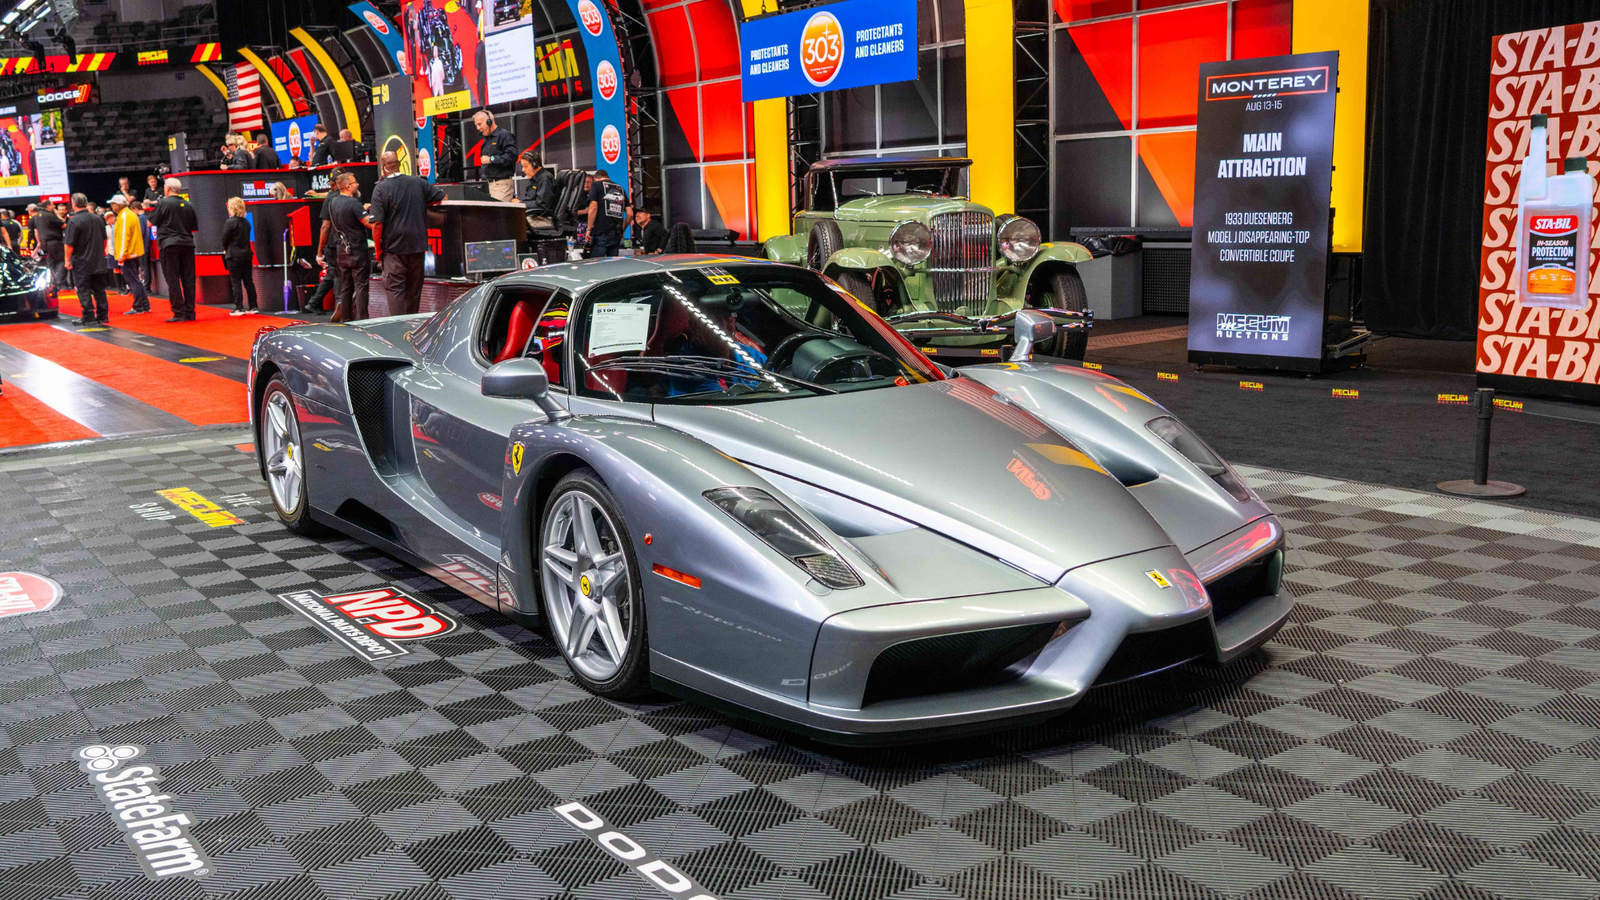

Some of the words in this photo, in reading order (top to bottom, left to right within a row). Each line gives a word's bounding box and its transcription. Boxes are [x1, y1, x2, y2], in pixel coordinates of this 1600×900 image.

[582, 9, 600, 26] 303
[856, 23, 903, 43] PROTECTANTS
[750, 44, 789, 62] PROTECTANTS
[804, 34, 839, 65] 303
[855, 45, 869, 59] AND
[869, 39, 904, 57] CLEANERS
[750, 63, 762, 76] AND
[761, 58, 790, 74] CLEANERS
[598, 73, 615, 89] 303
[1212, 74, 1322, 94] MONTEREY
[37, 89, 80, 103] DODGE
[1245, 102, 1262, 111] AUG
[1263, 100, 1283, 110] 13-15
[602, 138, 619, 152] 303
[1242, 132, 1283, 153] MAIN
[1217, 157, 1307, 179] ATTRACTION
[1225, 212, 1243, 226] 1933
[1243, 212, 1293, 225] DUESENBERG
[1534, 218, 1572, 230] STA-BIL
[1207, 231, 1232, 243] MODEL
[1233, 231, 1238, 243] J
[1238, 231, 1310, 244] DISAPPEARING-TOP
[1219, 249, 1268, 262] CONVERTIBLE
[1269, 249, 1295, 262] COUPE
[1531, 246, 1574, 257] PROTECTION
[1217, 313, 1291, 334] MECUM
[1216, 330, 1289, 341] AUCTIONS
[1082, 362, 1103, 370] MECUM
[1157, 372, 1179, 380] MECUM
[1239, 381, 1264, 389] MECUM
[1332, 388, 1359, 396] MECUM
[1437, 394, 1468, 402] MECUM
[1492, 398, 1524, 409] MECUM
[156, 487, 245, 528] MECUM
[220, 492, 261, 508] THE
[129, 502, 177, 521] SHOP
[323, 589, 447, 638] NPD
[290, 592, 333, 624] NATIONAL
[328, 617, 360, 638] PARTS
[349, 632, 393, 656] DEPOT
[554, 801, 719, 900] DOD
